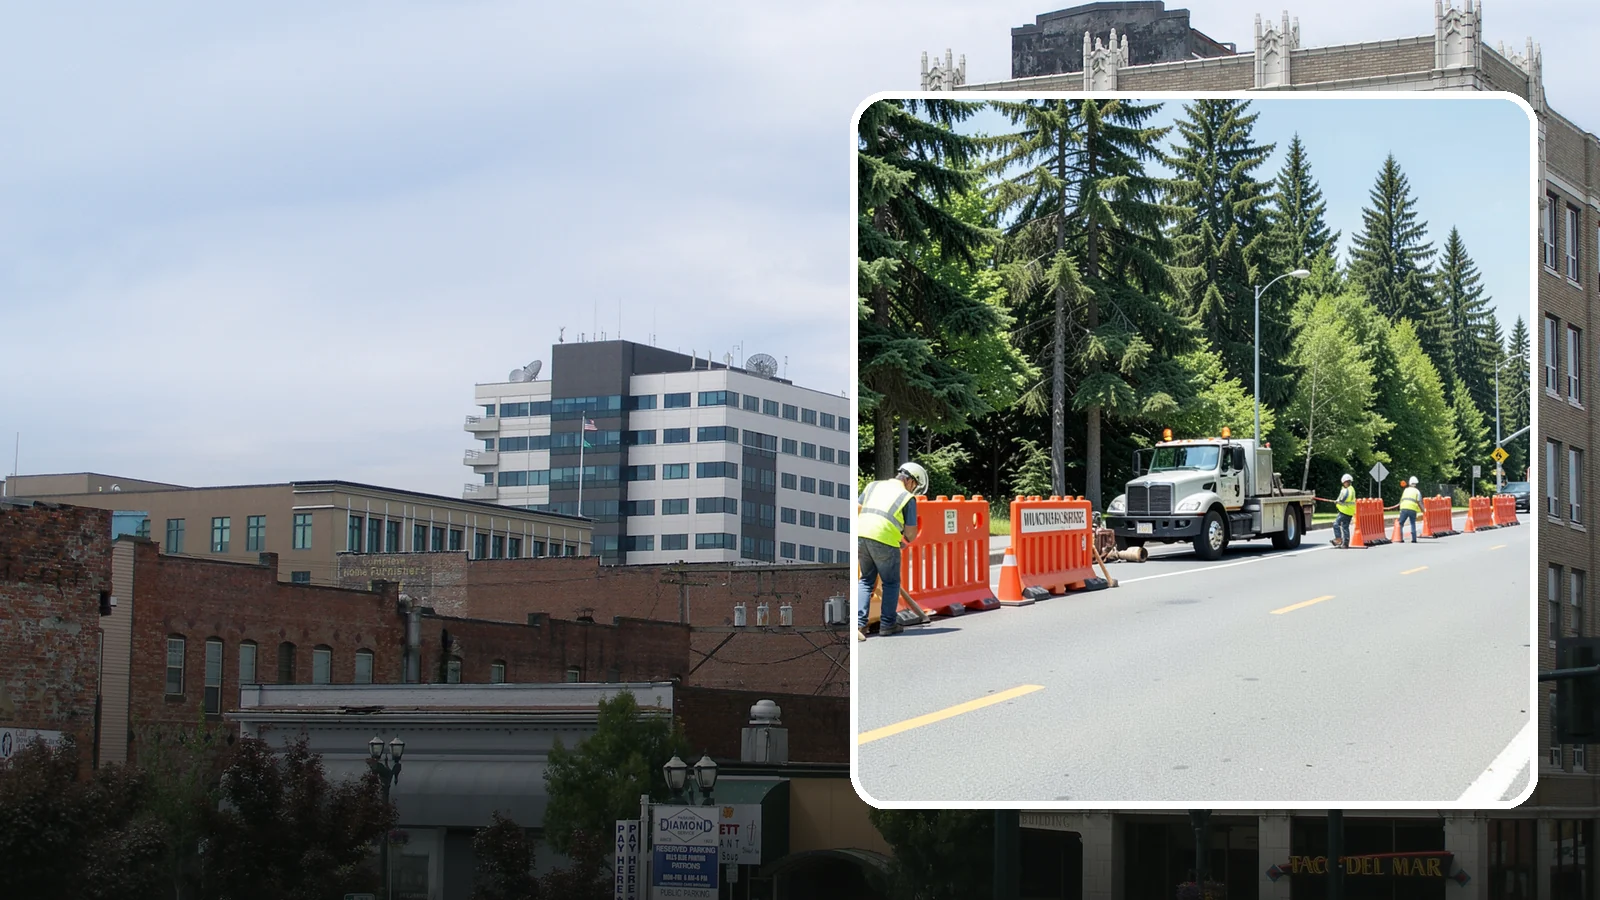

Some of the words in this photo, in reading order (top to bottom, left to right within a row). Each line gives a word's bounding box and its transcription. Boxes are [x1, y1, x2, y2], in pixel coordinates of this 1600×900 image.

[371, 566, 427, 577] Furnishers
[660, 818, 713, 833] DIAMOND
[1022, 814, 1070, 828] BUILDING
[720, 824, 740, 835] ETT
[617, 825, 625, 852] PAY
[628, 825, 637, 852] PAY
[720, 839, 740, 849] ANT
[656, 845, 688, 853] RESERVED
[689, 846, 716, 854] PARKING
[721, 851, 739, 861] Soup
[671, 862, 701, 870] PATRONS
[1289, 855, 1330, 874] TAC
[1346, 856, 1384, 875] DEL
[1392, 857, 1443, 876] MAR
[616, 856, 625, 893] HERE
[627, 856, 636, 893] HERE
[660, 888, 682, 897] PUBLIC
[683, 889, 711, 898] PARKING
